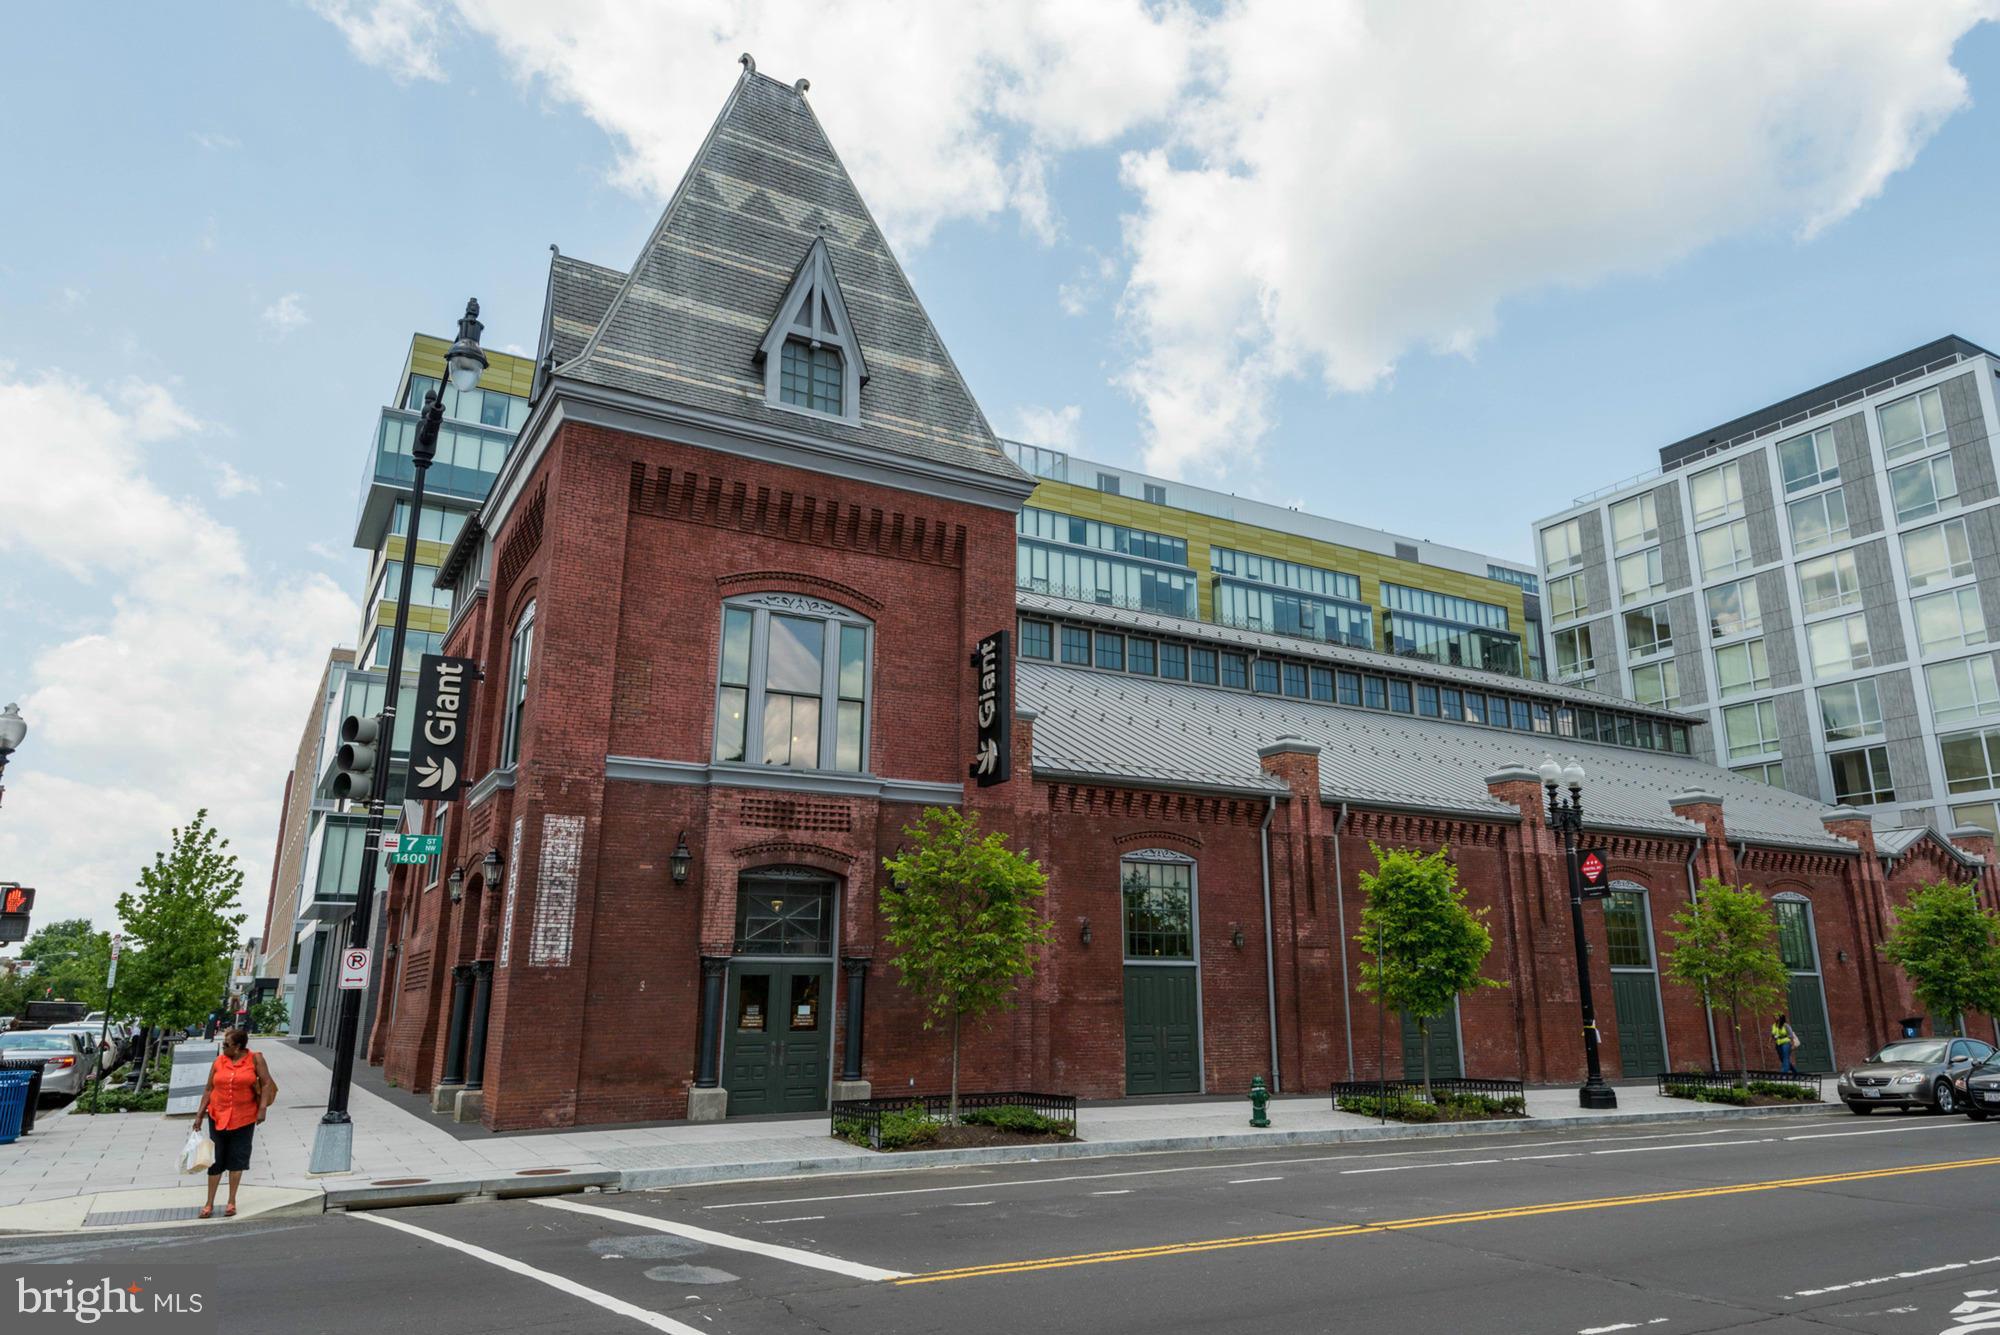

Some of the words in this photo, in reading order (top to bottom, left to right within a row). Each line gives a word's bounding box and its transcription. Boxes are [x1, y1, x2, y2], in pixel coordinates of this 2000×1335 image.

[424, 662, 464, 746] Giant
[978, 639, 996, 729] Giant
[395, 853, 427, 863] 1400
[406, 837, 419, 850] 7
